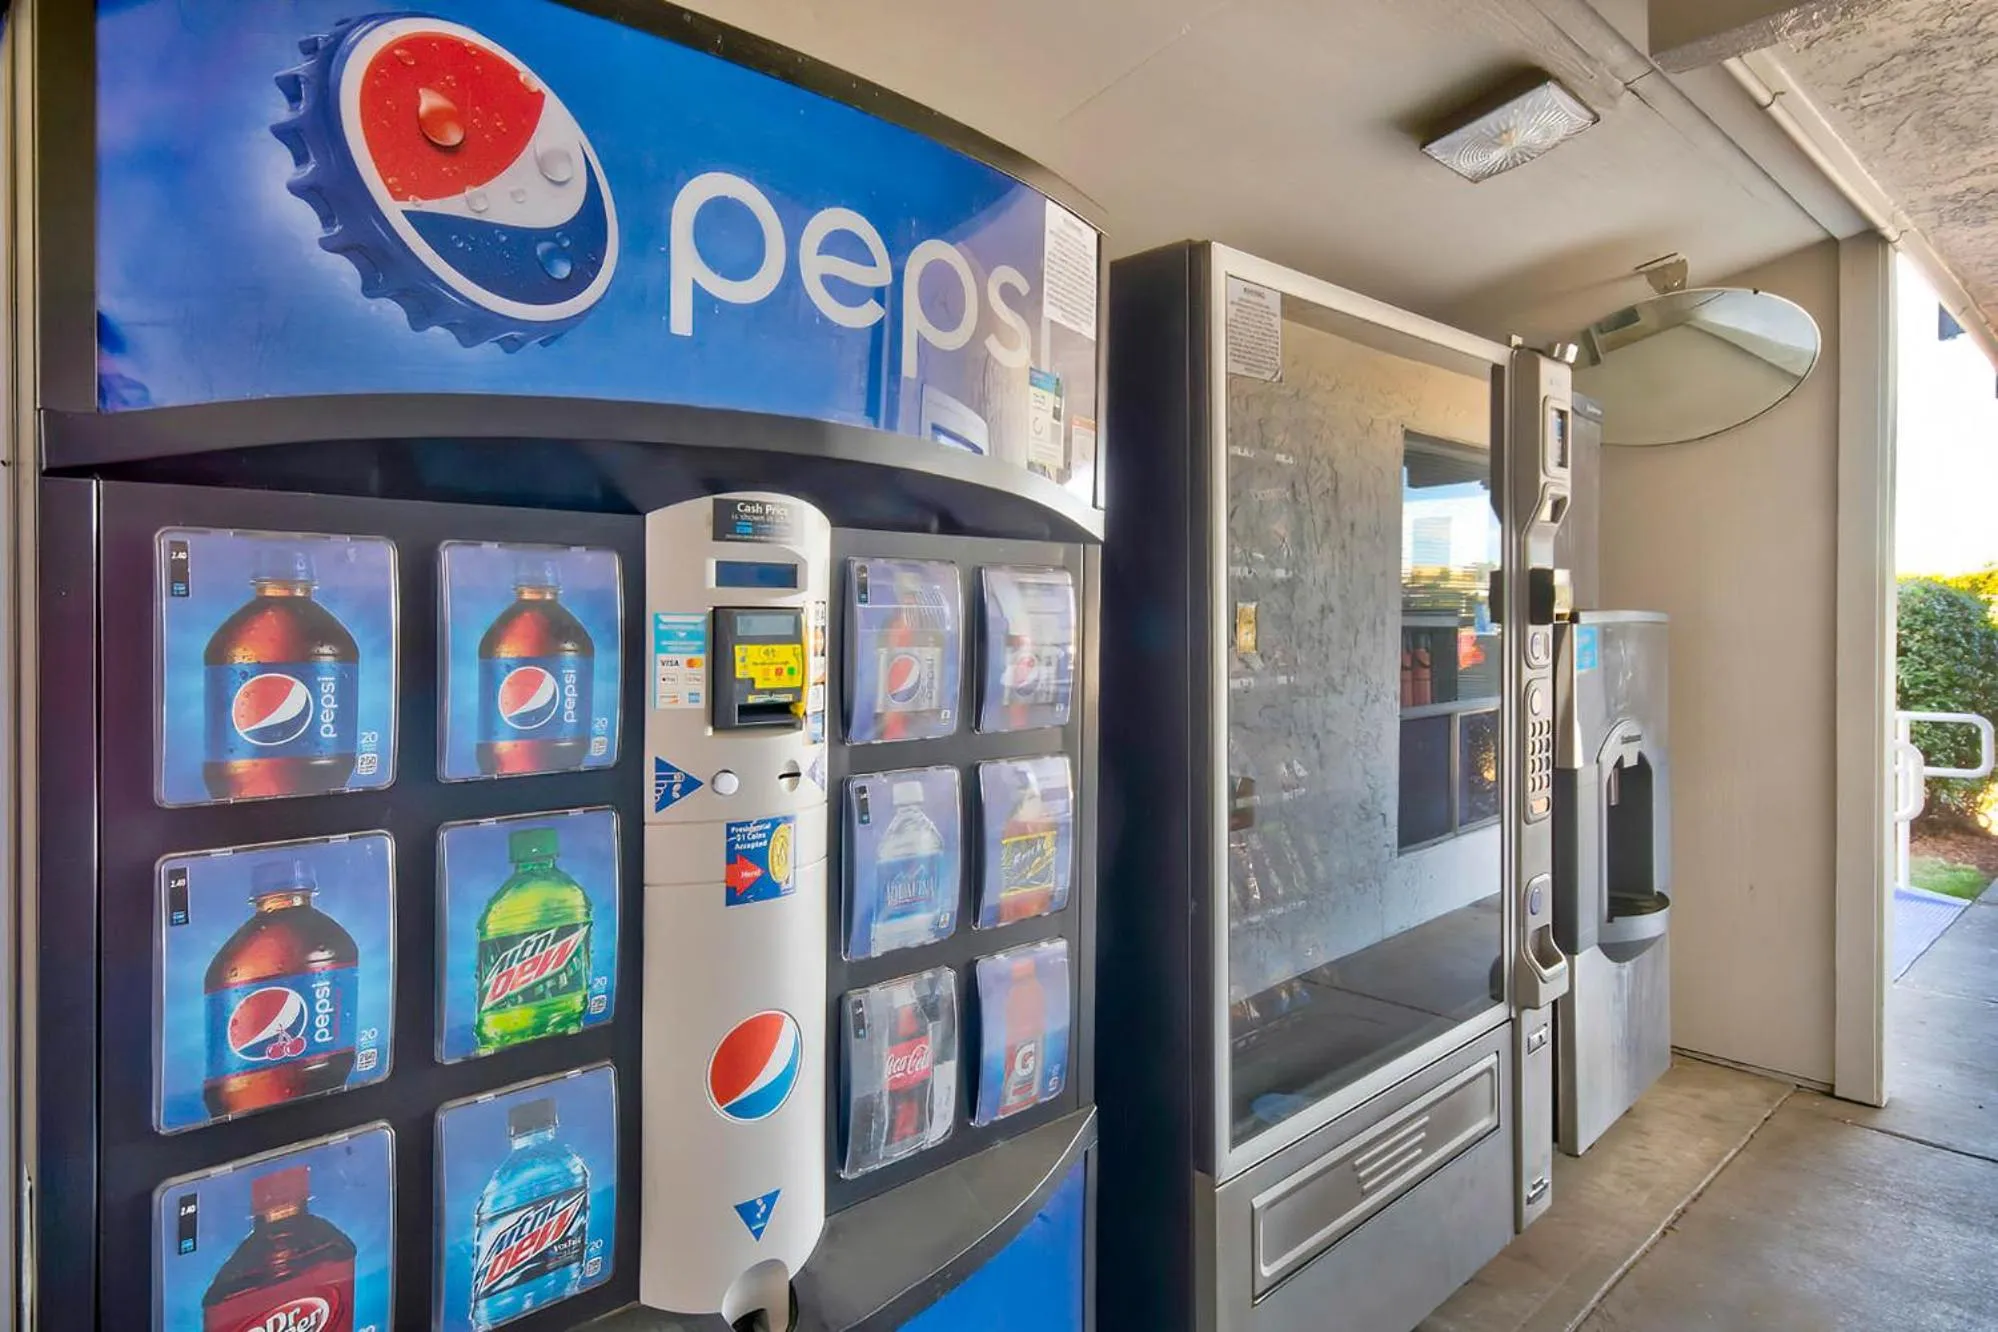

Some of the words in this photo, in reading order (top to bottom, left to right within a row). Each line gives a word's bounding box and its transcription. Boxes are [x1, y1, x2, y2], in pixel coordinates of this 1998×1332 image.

[737, 502, 763, 514] Cash
[660, 659, 680, 667] VISA
[316, 676, 339, 739] pepsi
[562, 668, 579, 723] pepsi
[311, 980, 335, 1043] pepsi
